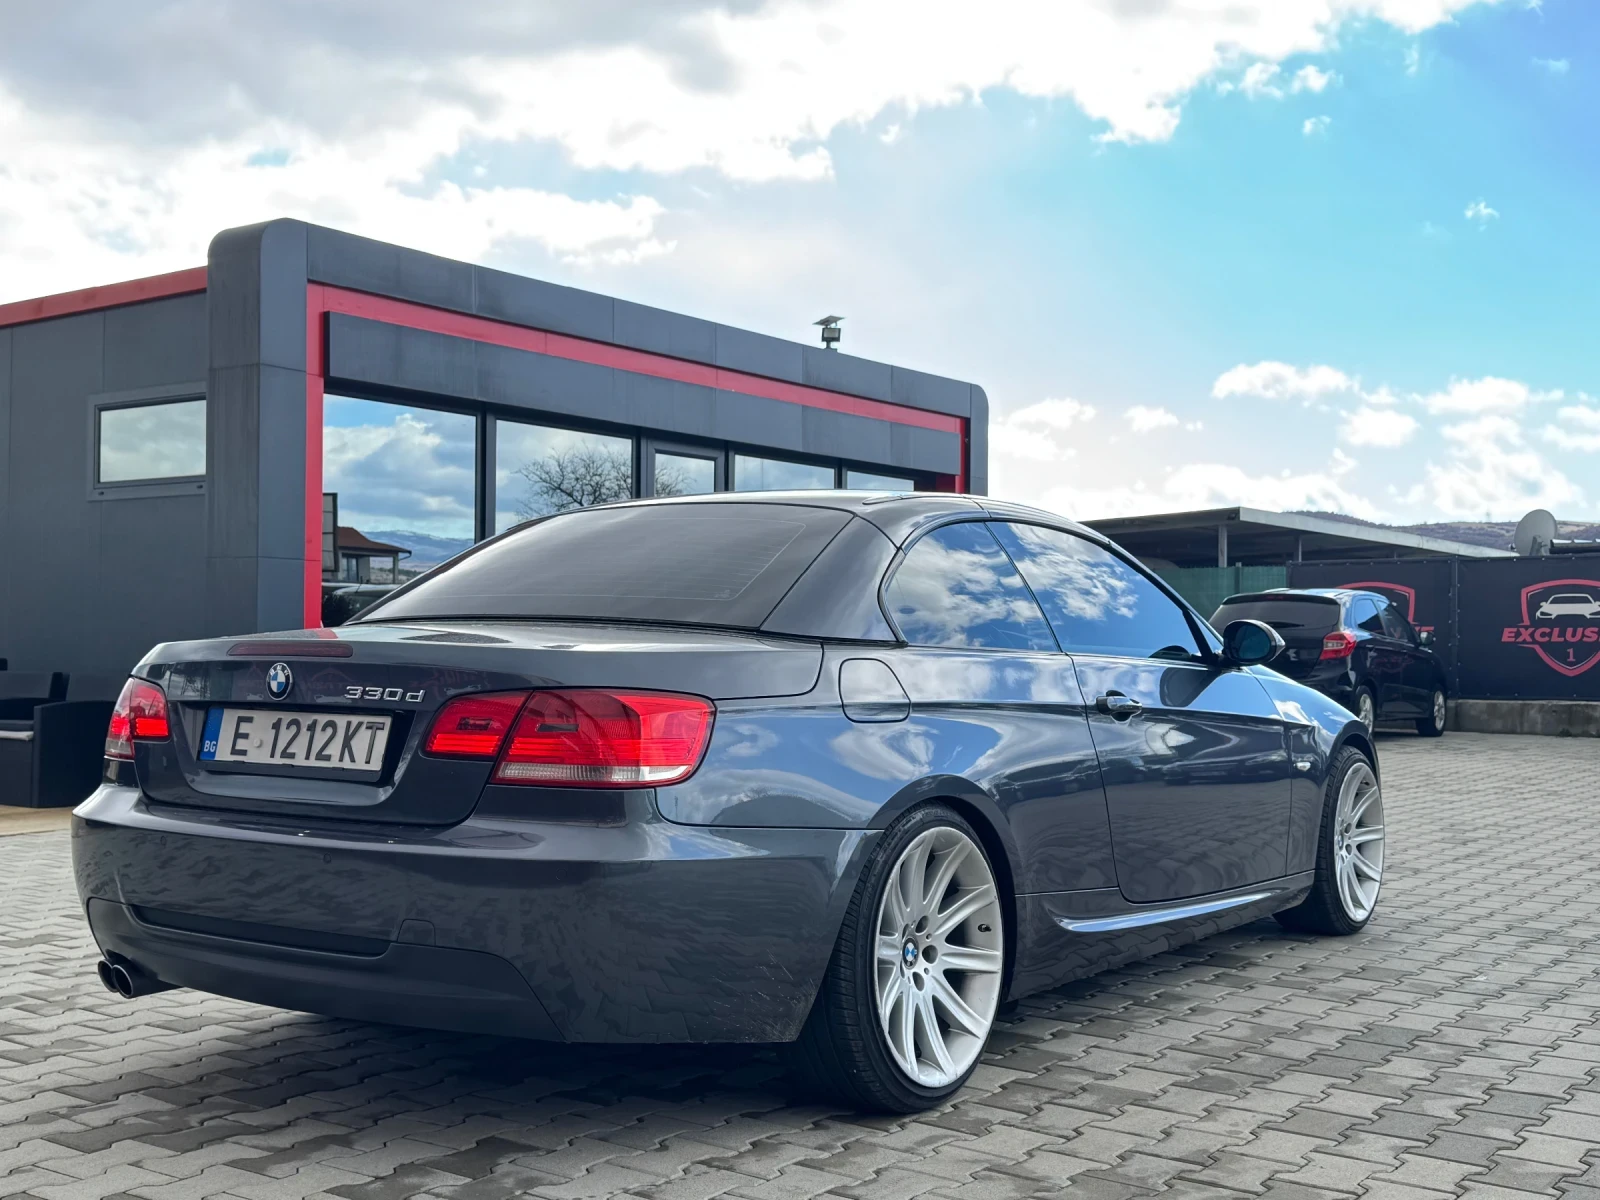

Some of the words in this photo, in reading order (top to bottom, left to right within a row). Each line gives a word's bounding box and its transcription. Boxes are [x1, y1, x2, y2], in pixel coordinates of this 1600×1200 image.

[1501, 627, 1600, 642] EXCLUS
[1566, 648, 1576, 661] 1
[344, 686, 426, 702] 330d
[203, 740, 217, 752] BG
